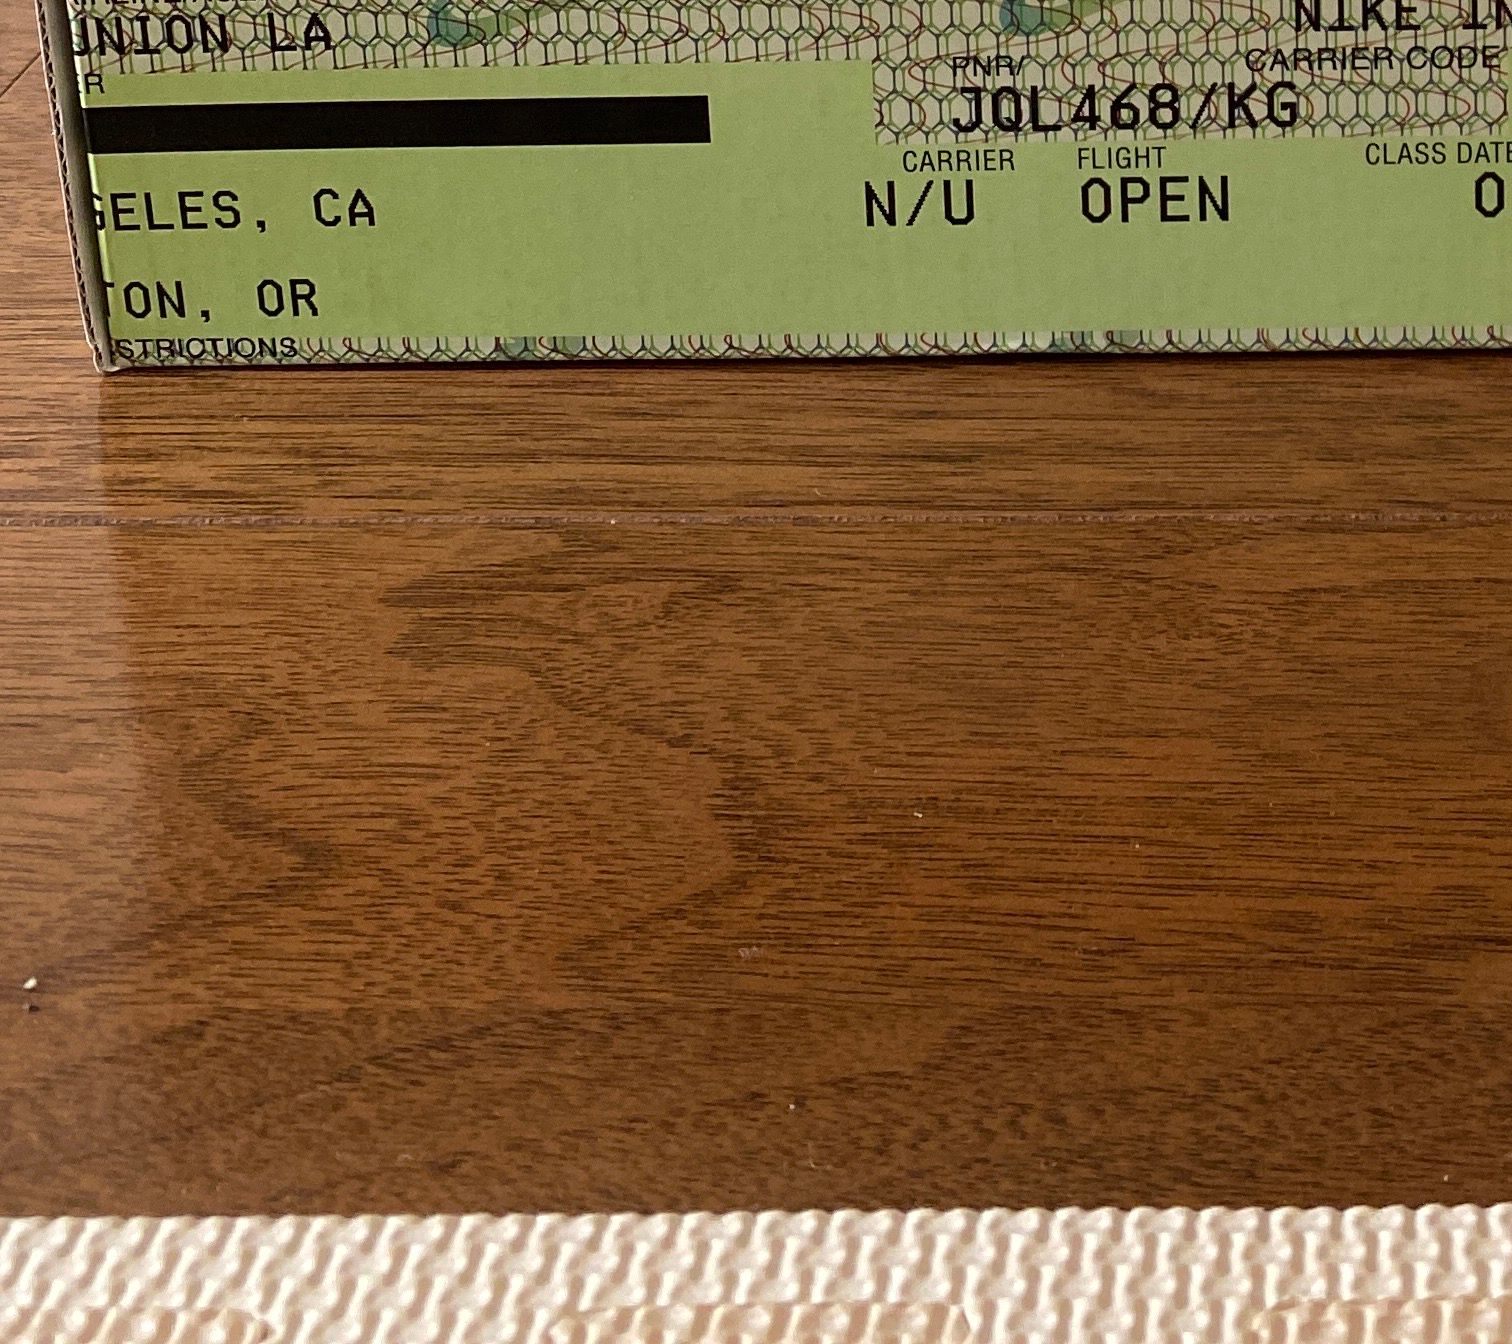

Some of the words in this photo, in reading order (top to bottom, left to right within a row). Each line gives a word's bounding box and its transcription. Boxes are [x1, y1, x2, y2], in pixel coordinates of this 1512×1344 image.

[268, 11, 334, 53] LA
[952, 55, 1026, 78] PNR/
[1244, 47, 1395, 72] CARRIER
[1405, 45, 1502, 70] CODE
[952, 80, 1300, 135] JQL468/KG
[901, 147, 1017, 174] CARRIER
[1076, 145, 1168, 171] FLIGHT
[1364, 142, 1448, 167] CLASS
[312, 187, 376, 228] CA
[865, 178, 976, 227] N/U
[1080, 174, 1231, 225] OPEN
[256, 278, 319, 318] OR
[111, 336, 299, 360] STRICTIONS
